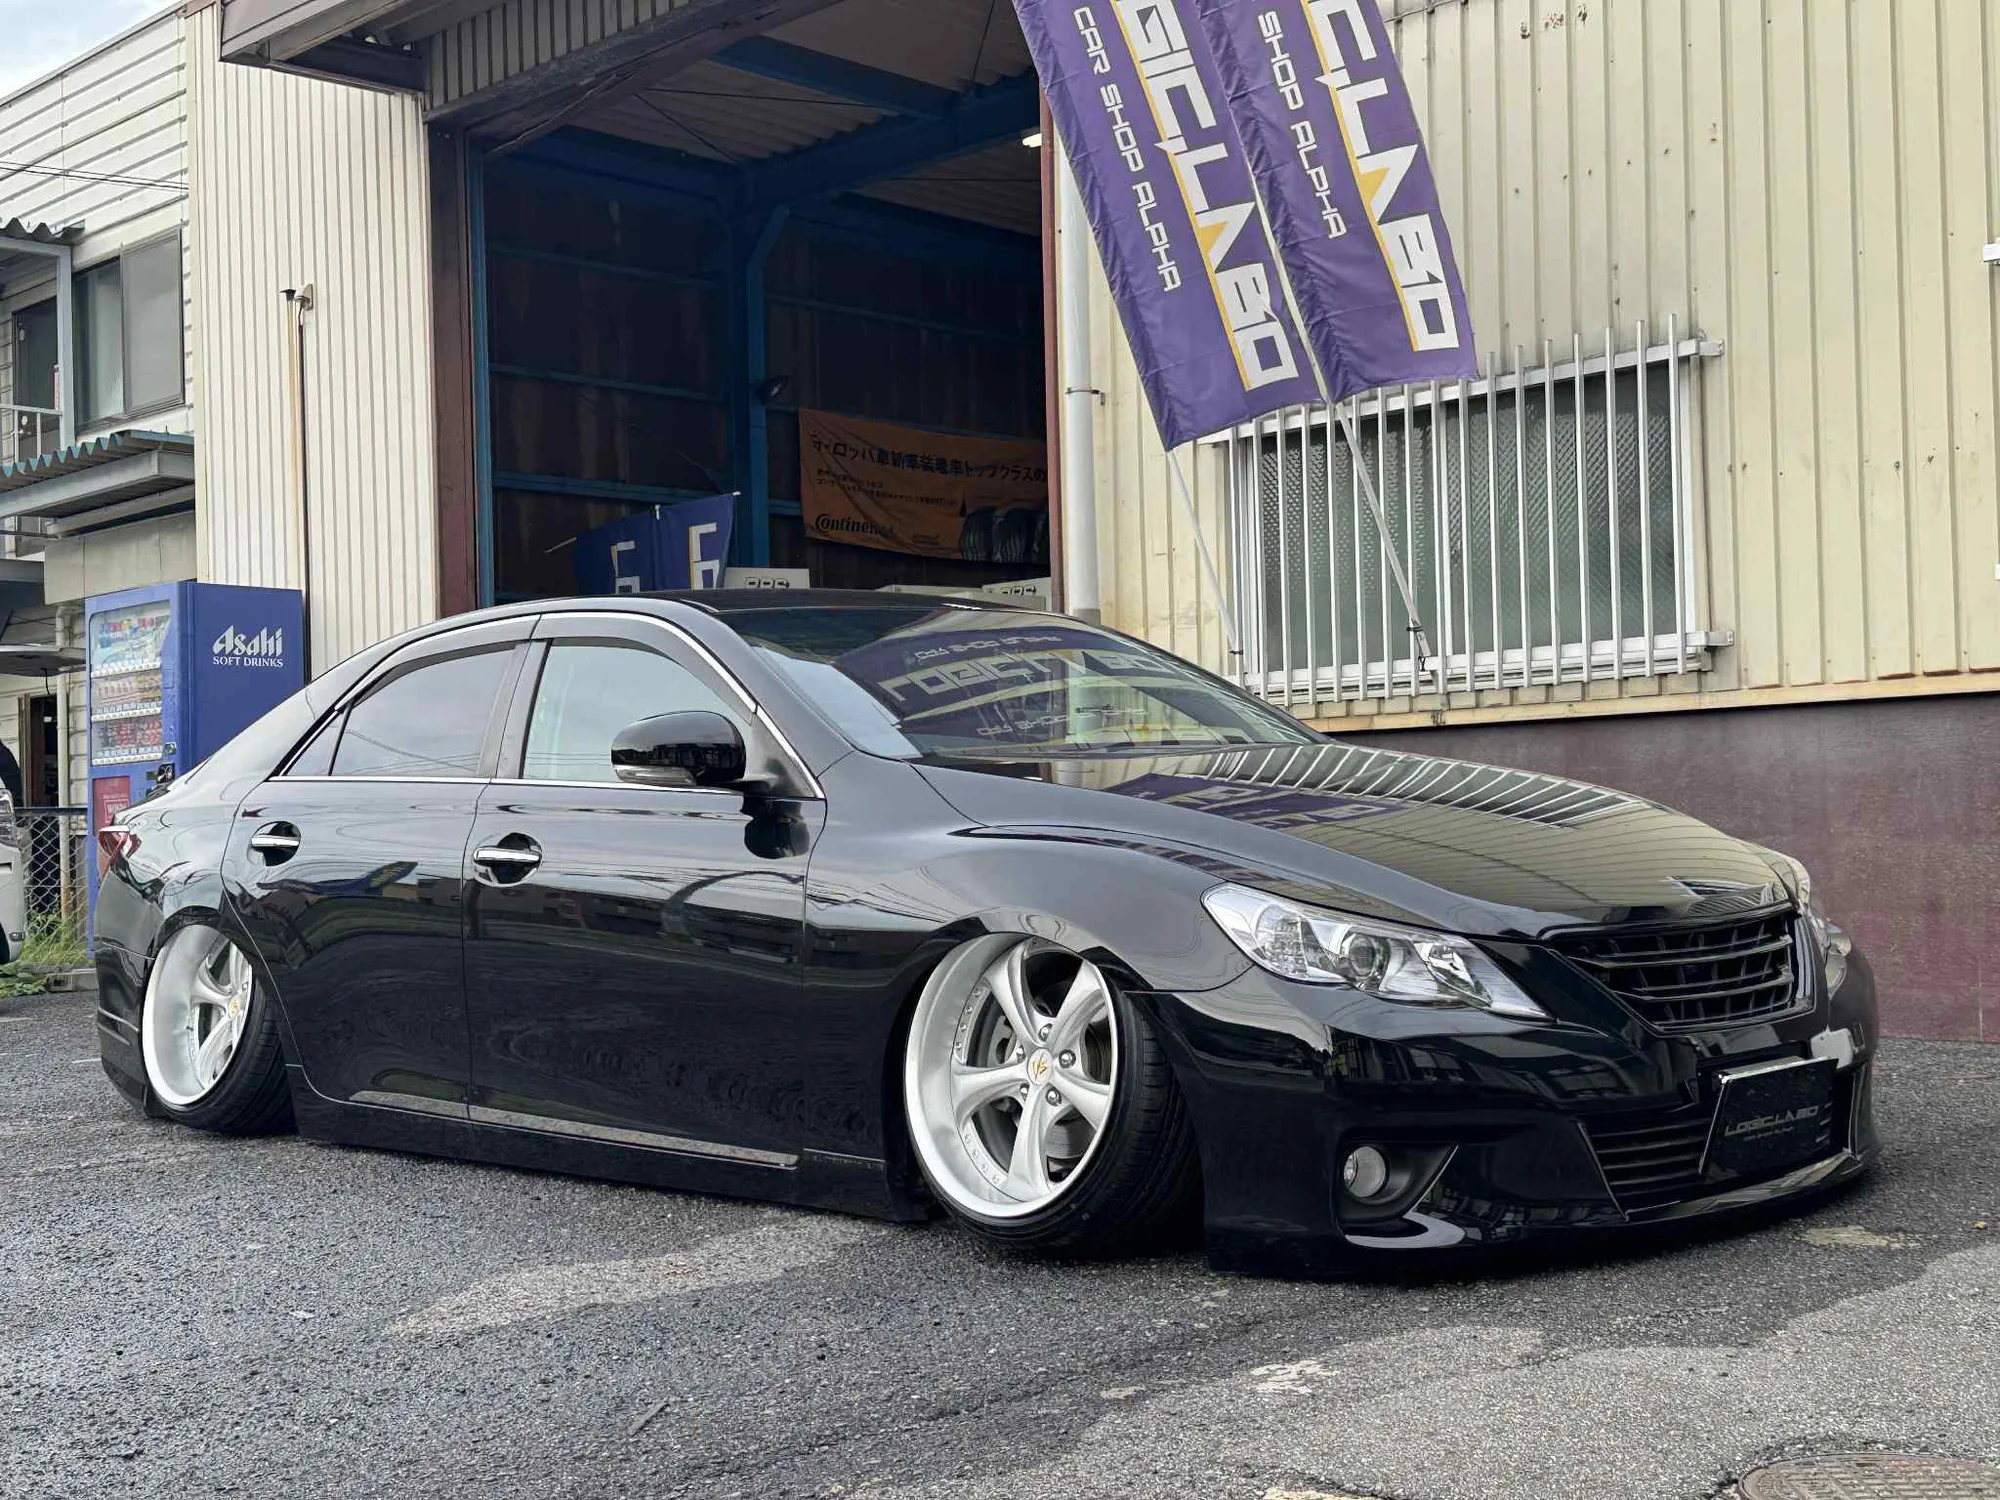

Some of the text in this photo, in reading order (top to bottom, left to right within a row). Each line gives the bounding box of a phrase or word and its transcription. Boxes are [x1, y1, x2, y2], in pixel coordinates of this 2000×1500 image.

[1073, 6, 1183, 292] CAR SHOP ALPHA
[1257, 11, 1347, 239] SHOP ALPHA
[212, 625, 283, 657] Asahi
[213, 656, 283, 668] SOFT DRINKS
